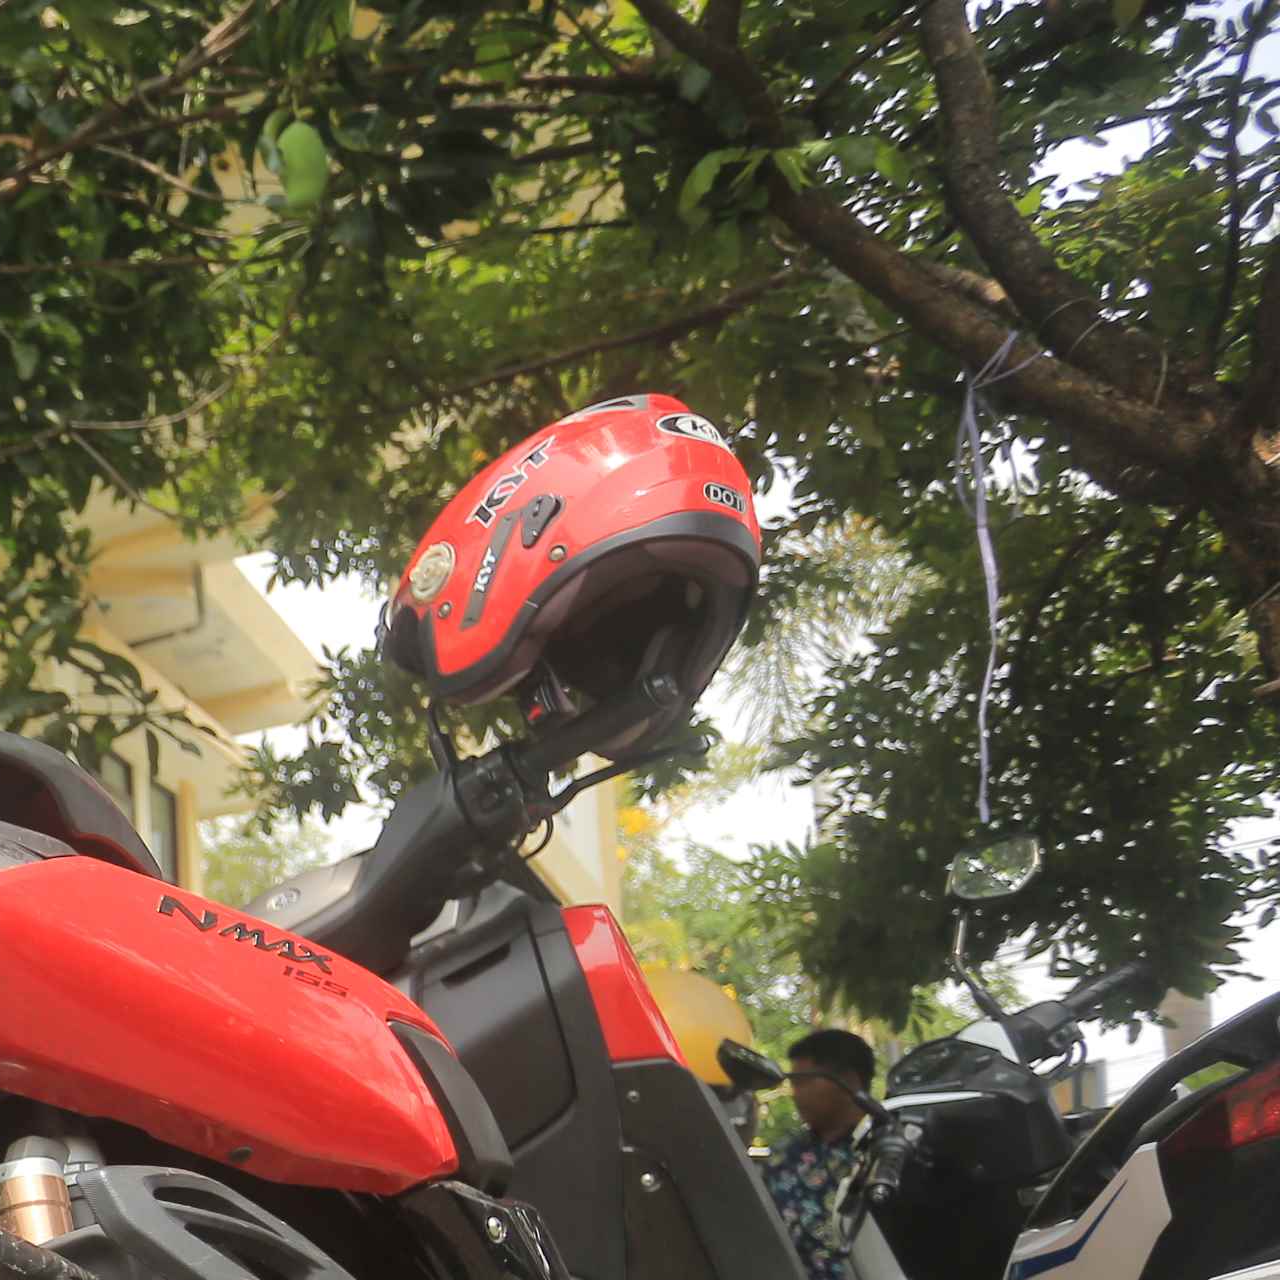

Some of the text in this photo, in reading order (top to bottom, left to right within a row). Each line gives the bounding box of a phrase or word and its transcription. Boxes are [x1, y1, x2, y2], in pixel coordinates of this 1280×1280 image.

[464, 434, 556, 529] KYT
[157, 894, 333, 976] NMAX
[283, 965, 350, 998] 155
